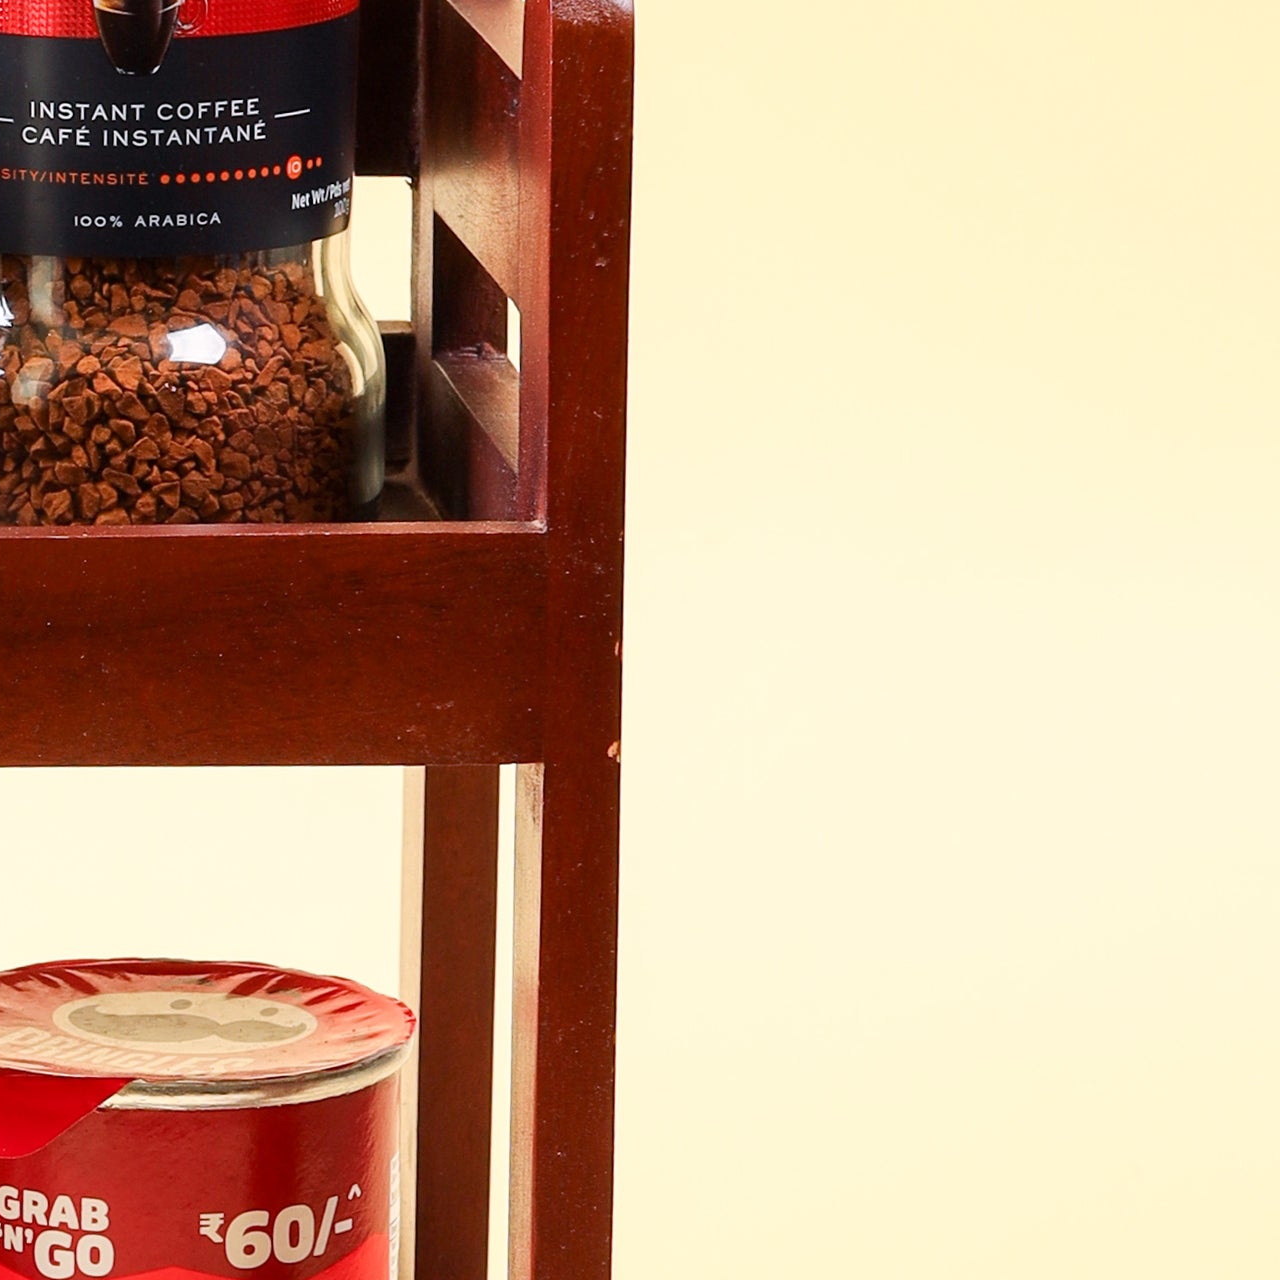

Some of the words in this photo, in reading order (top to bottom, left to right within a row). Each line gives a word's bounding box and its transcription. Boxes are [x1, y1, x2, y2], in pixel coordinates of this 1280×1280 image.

[29, 101, 145, 122] INSTANT
[156, 98, 260, 121] COFFEE
[21, 126, 91, 147] CAFÉ
[102, 120, 267, 148] INSTANTANÉ
[291, 192, 311, 210] Net
[73, 215, 123, 228] 100%
[135, 213, 221, 227] ARABICA
[33, 1230, 116, 1280] GO
